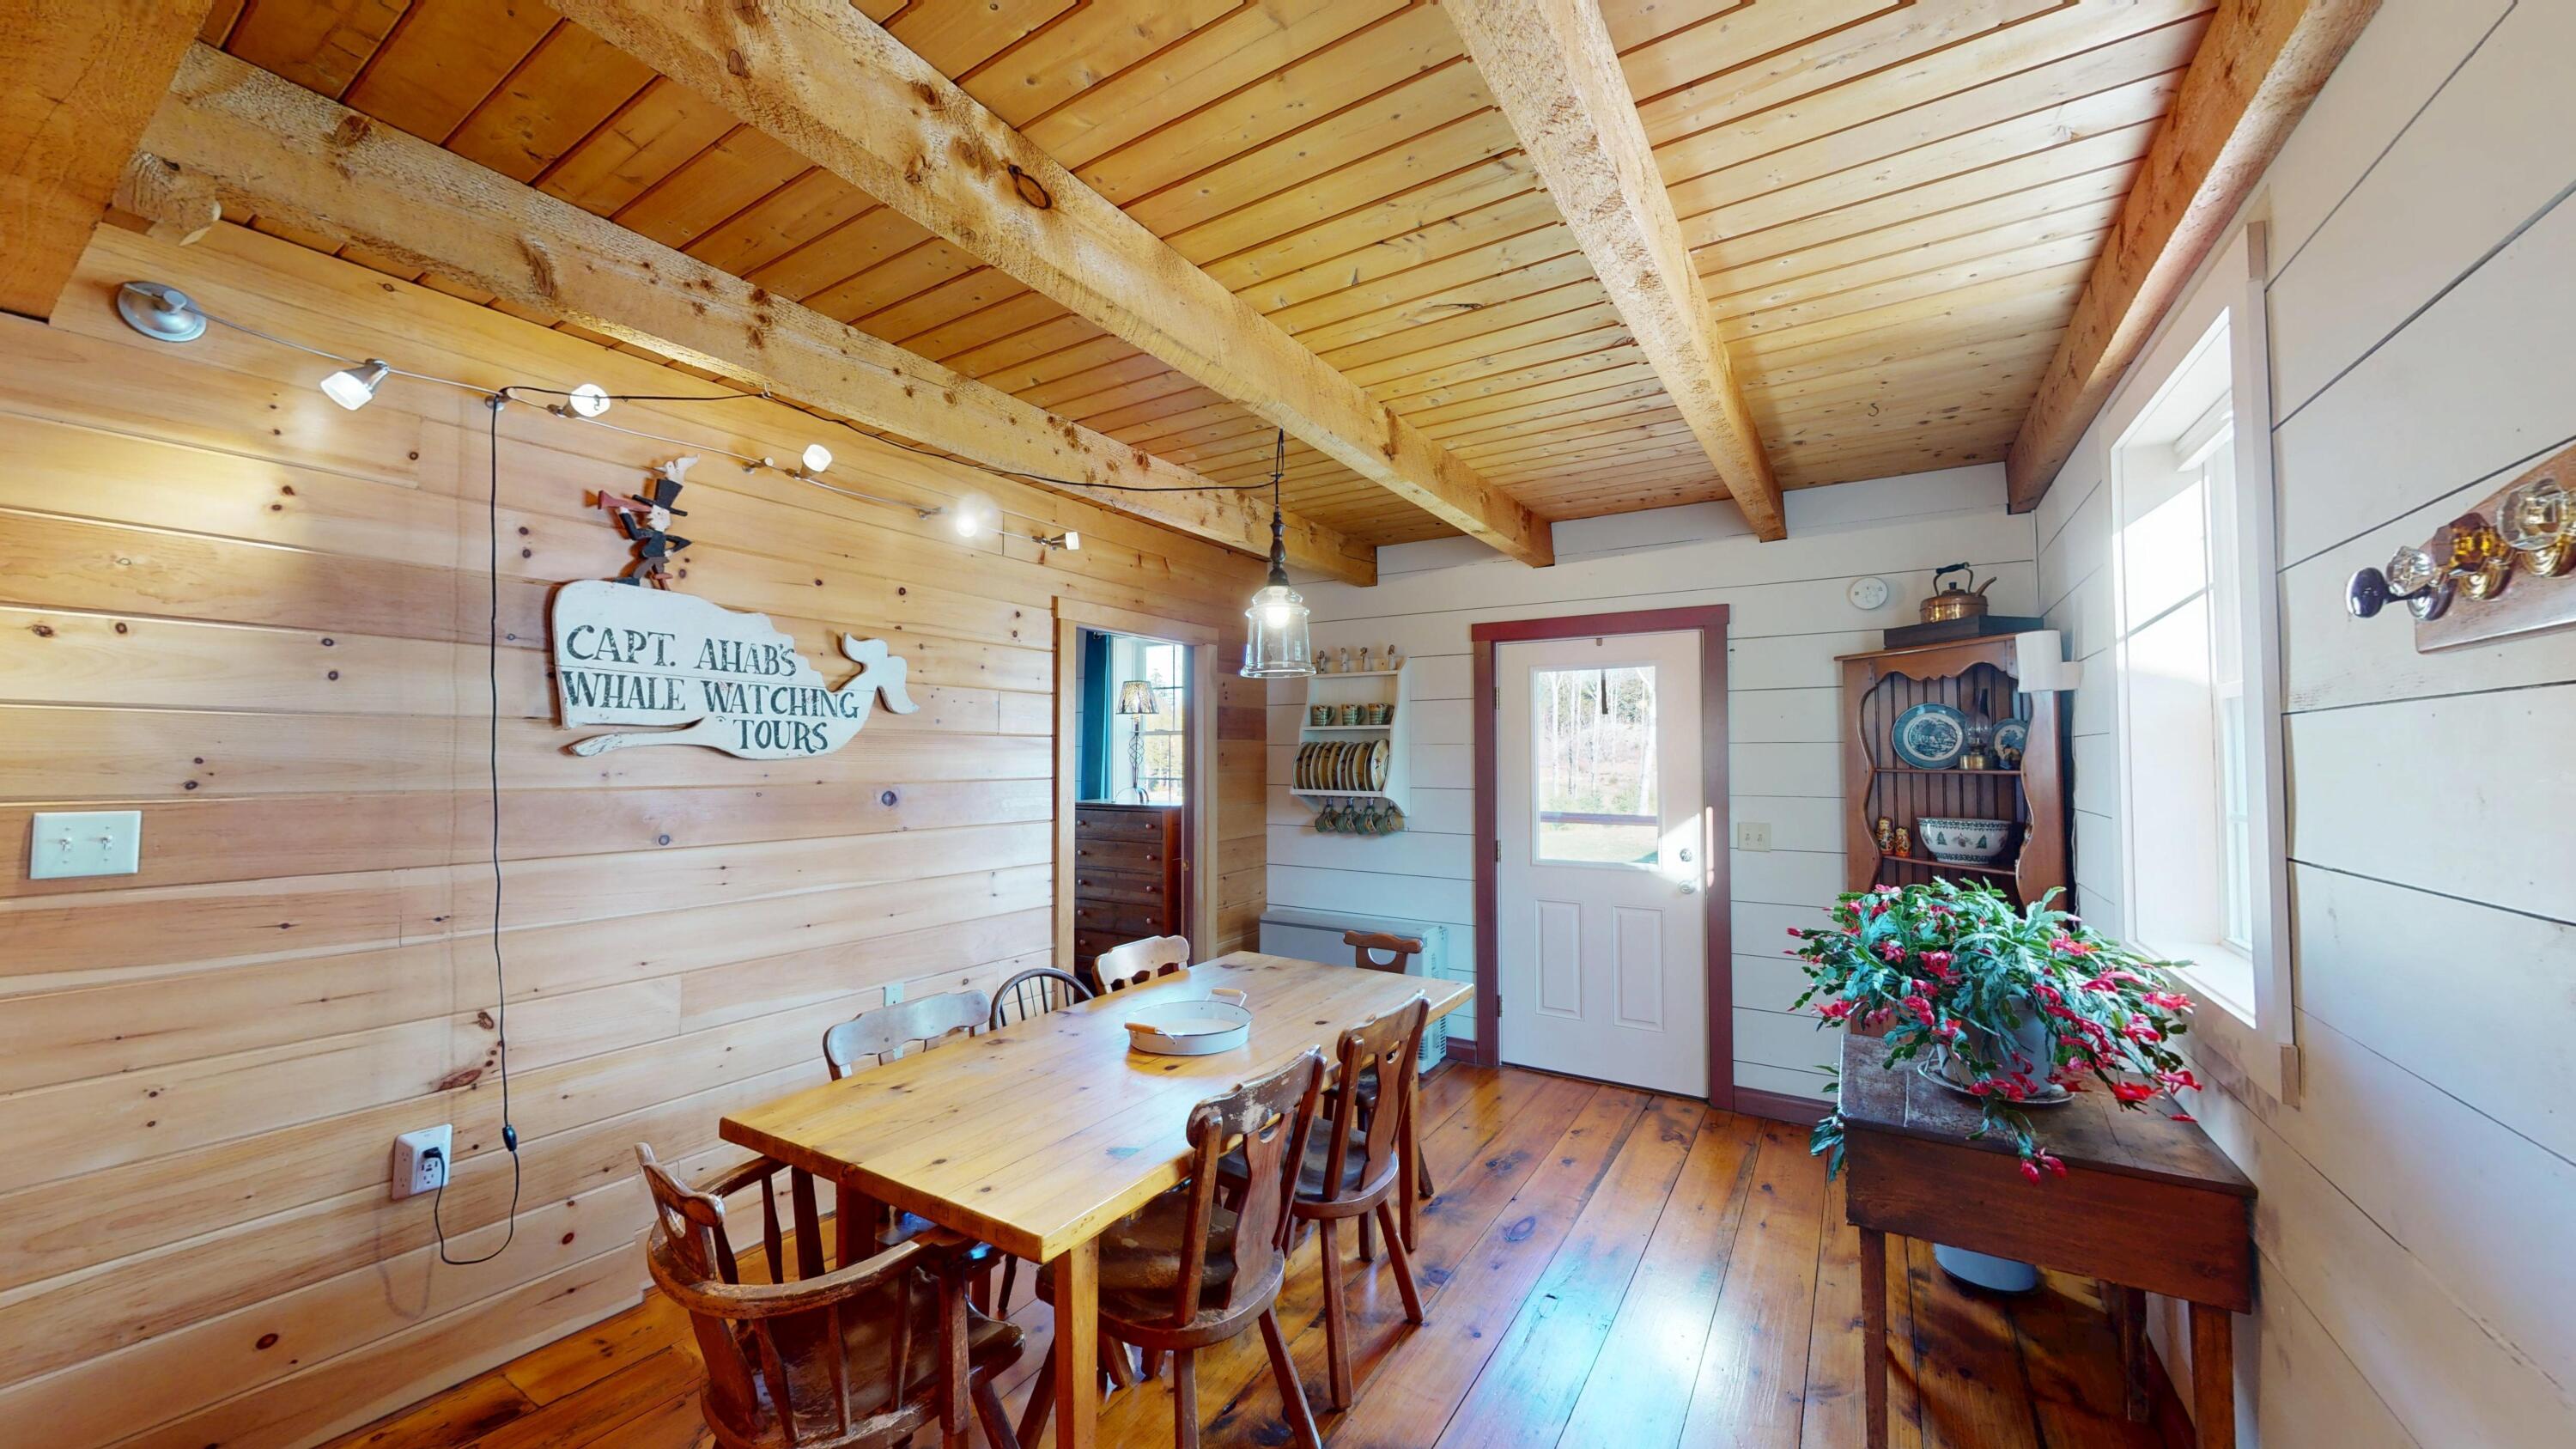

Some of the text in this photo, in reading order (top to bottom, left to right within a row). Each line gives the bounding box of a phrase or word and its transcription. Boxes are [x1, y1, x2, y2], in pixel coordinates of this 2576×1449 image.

[567, 624, 796, 677] CAPT. AHAB'S
[562, 671, 859, 720] WHALE WATCHING
[734, 720, 829, 754] TOURS
